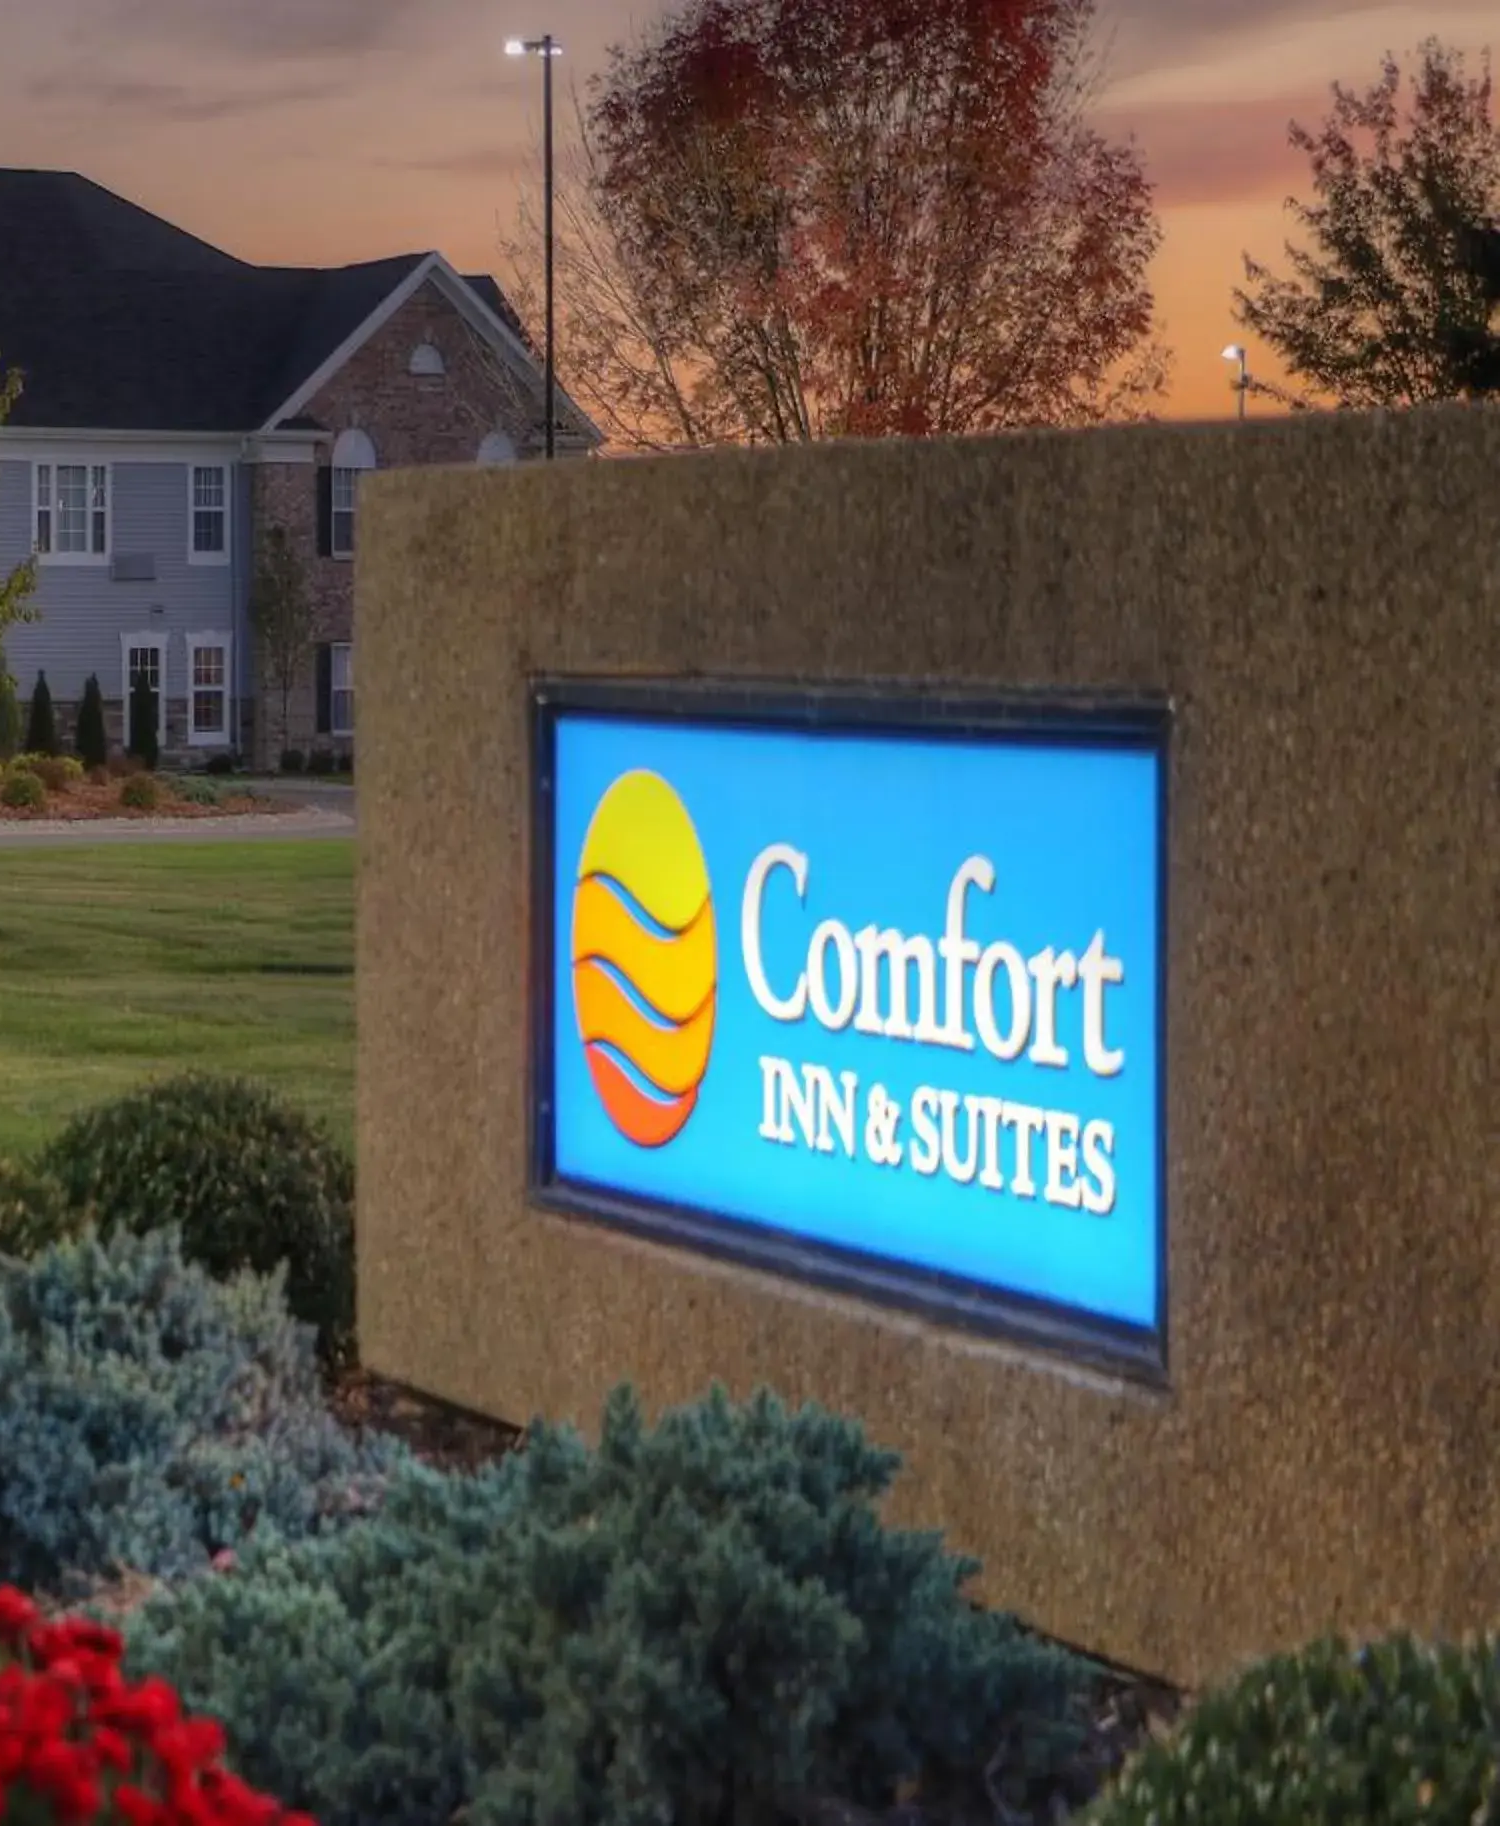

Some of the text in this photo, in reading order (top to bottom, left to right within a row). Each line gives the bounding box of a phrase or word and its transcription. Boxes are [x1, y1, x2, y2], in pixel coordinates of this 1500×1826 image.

[740, 842, 1125, 1077] Comfort
[757, 1055, 1116, 1216] INN & SUITES
